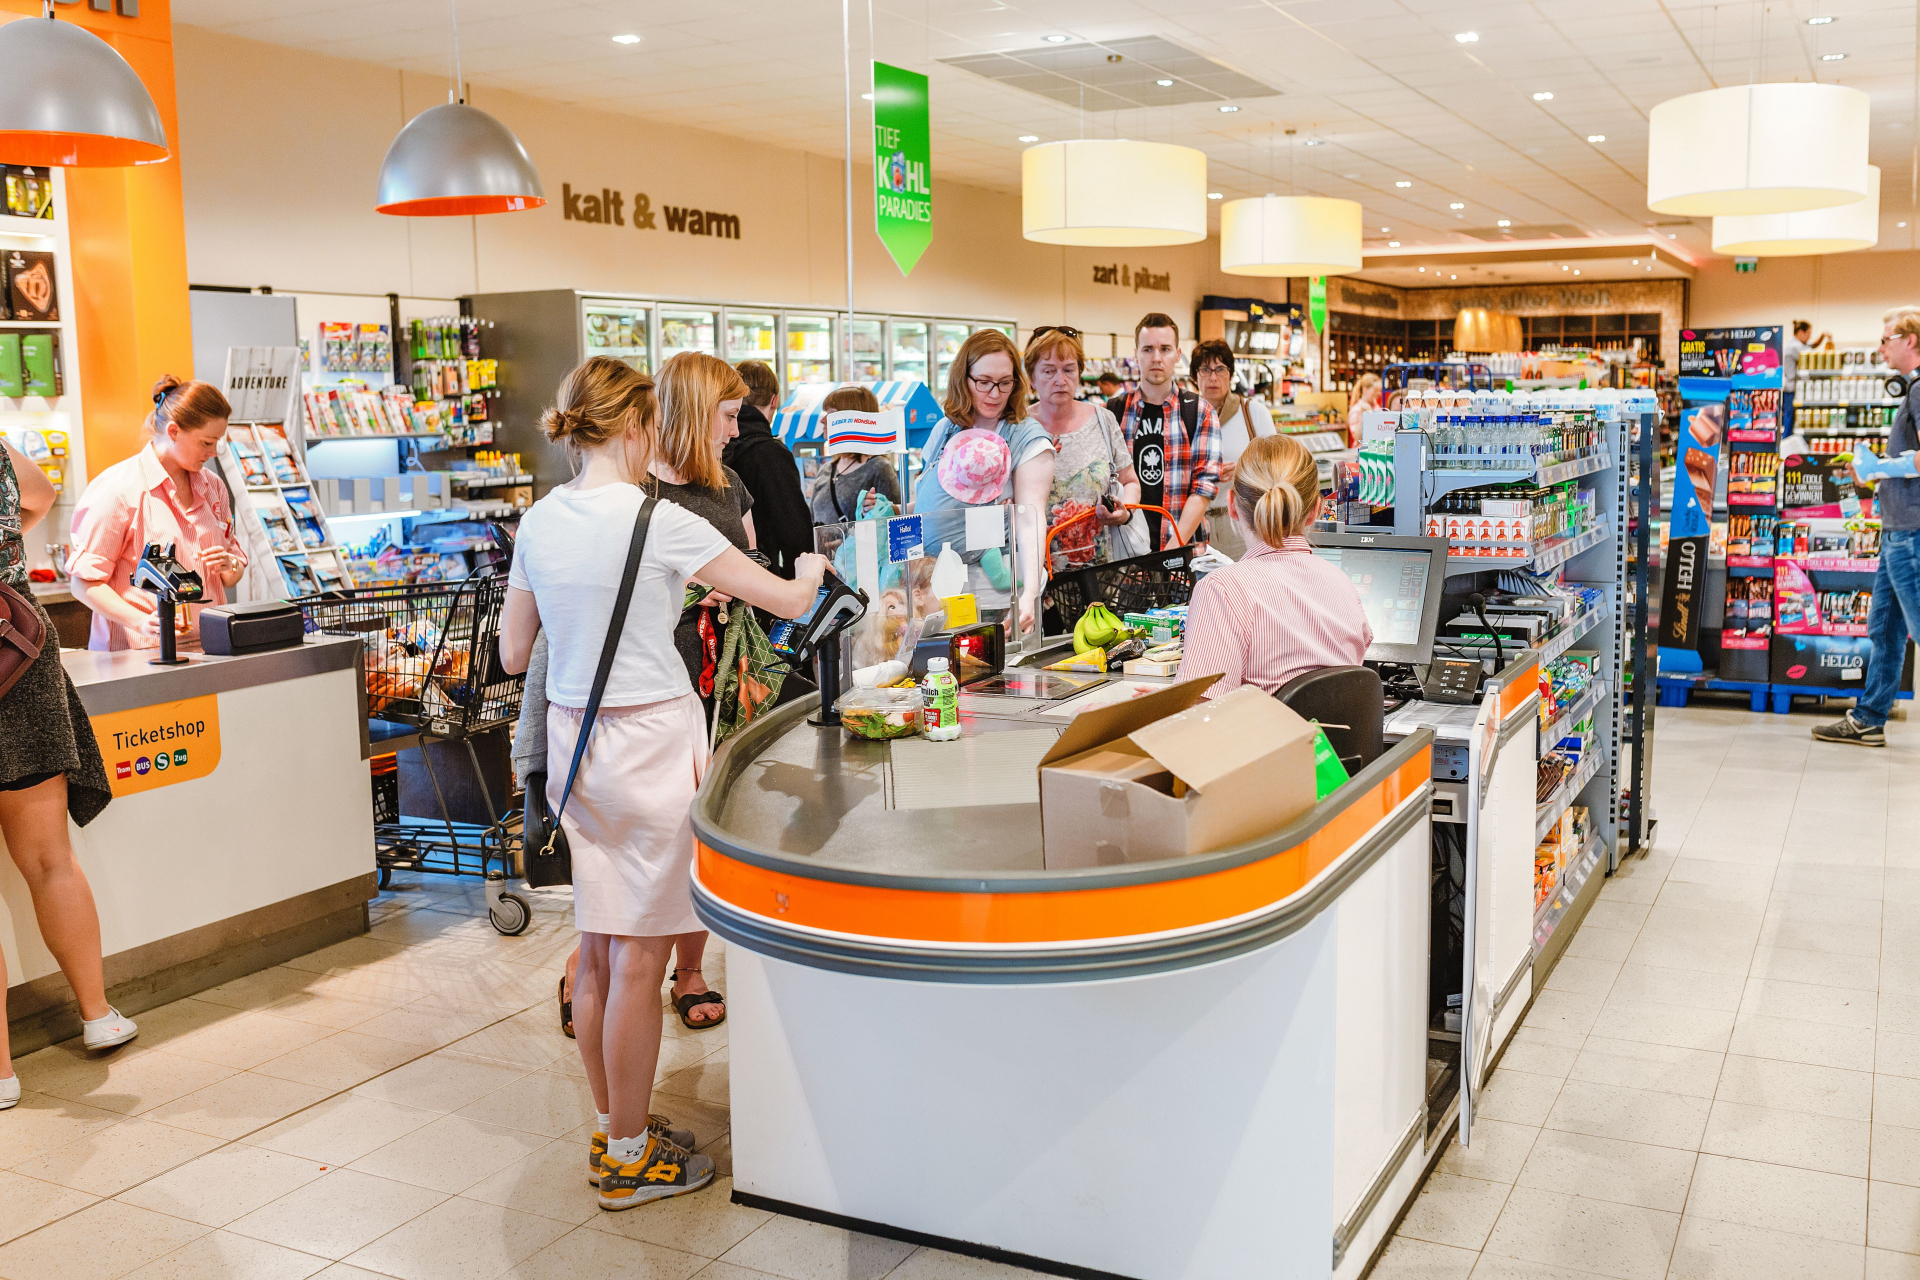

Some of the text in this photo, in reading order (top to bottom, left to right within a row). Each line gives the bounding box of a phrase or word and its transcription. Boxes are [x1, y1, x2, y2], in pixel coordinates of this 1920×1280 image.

[875, 125, 900, 149] TIEF
[877, 151, 931, 195] KHL
[562, 183, 741, 240] kalt & warm
[879, 194, 932, 222] PARADIES
[1093, 263, 1118, 285] zart
[1134, 266, 1171, 294] pikant
[1681, 341, 1705, 354] GRATIS
[231, 376, 288, 390] ADVENTURE
[853, 418, 877, 426] KONSUM
[1785, 471, 1823, 485] 111 COOLE
[1677, 541, 1696, 591] HELLO
[1776, 566, 1788, 575] 111
[1820, 654, 1863, 668] HELLO
[113, 720, 205, 750] Ticketshop
[117, 766, 131, 774] Tram
[136, 761, 150, 771] BUS
[156, 753, 169, 770] S
